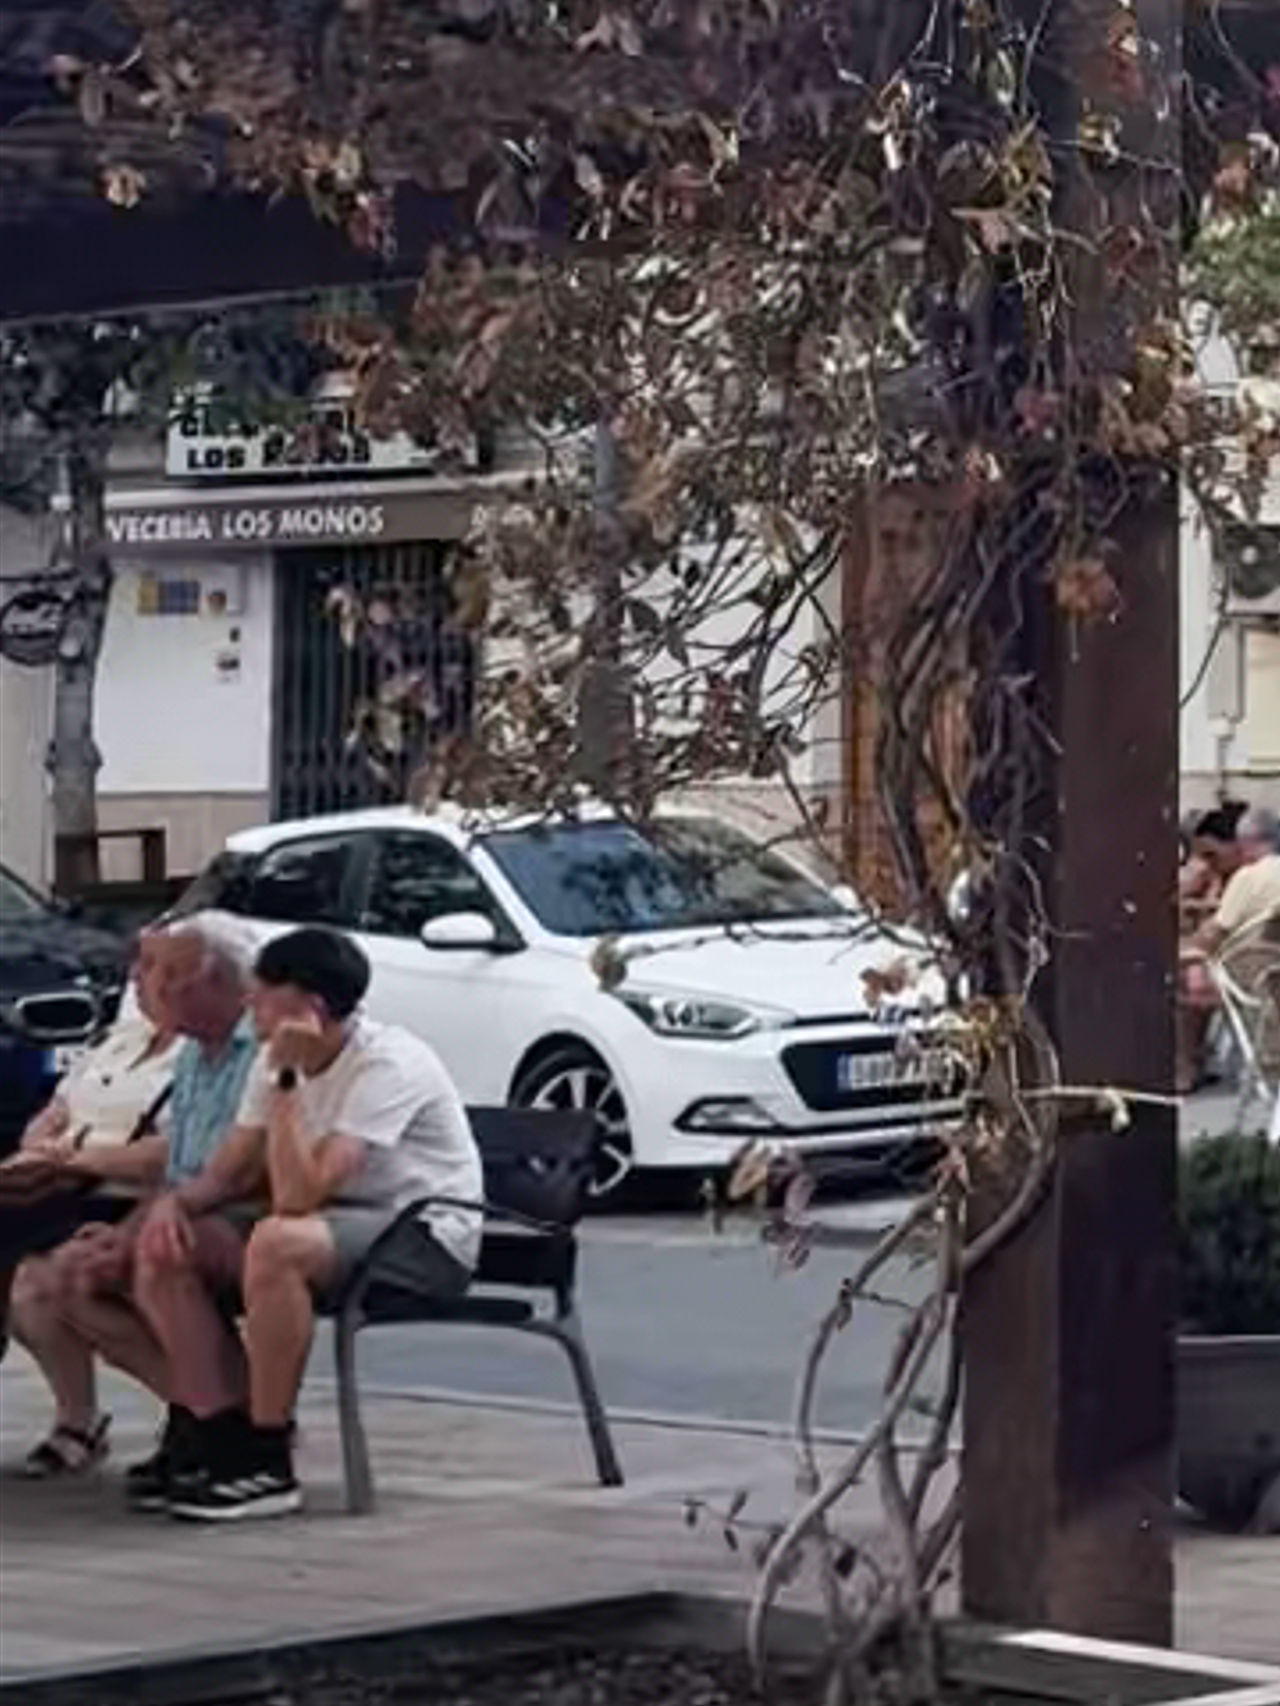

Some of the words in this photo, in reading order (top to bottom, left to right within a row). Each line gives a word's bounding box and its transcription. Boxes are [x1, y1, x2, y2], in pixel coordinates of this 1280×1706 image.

[187, 447, 246, 469] LOS
[222, 509, 272, 538] LOS
[278, 504, 384, 535] MONOS
